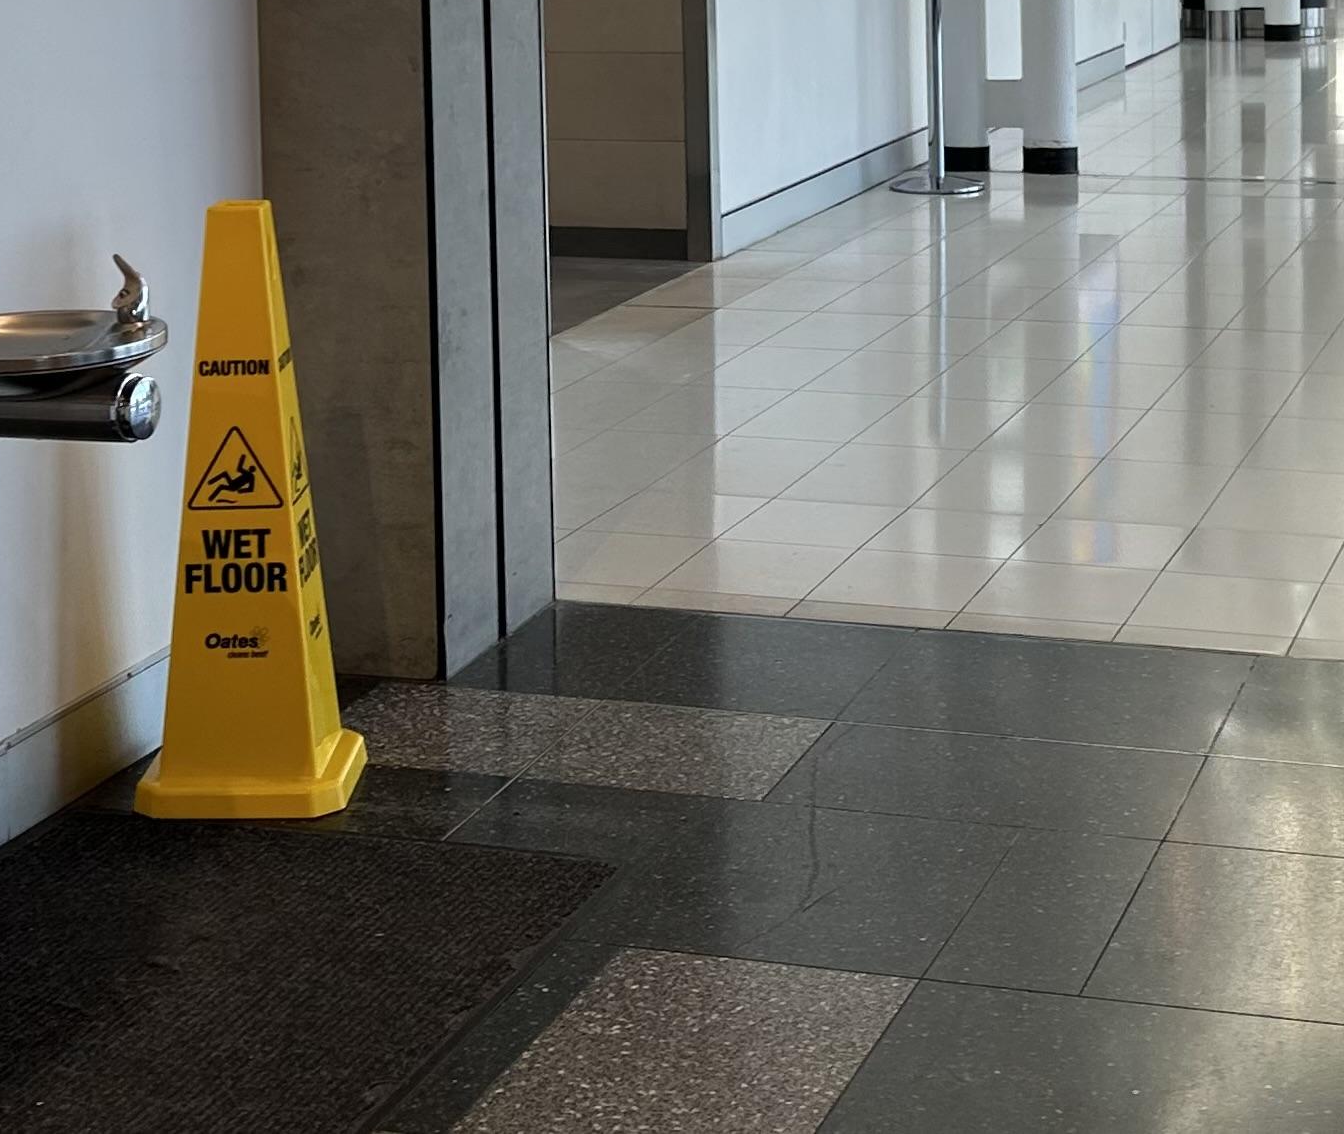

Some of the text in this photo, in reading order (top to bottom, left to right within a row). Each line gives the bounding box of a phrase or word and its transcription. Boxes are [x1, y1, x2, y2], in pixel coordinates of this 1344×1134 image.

[199, 360, 269, 377] CAUTION
[201, 528, 272, 560] WET
[184, 561, 288, 594] FLOOR
[204, 632, 259, 650] Oates
